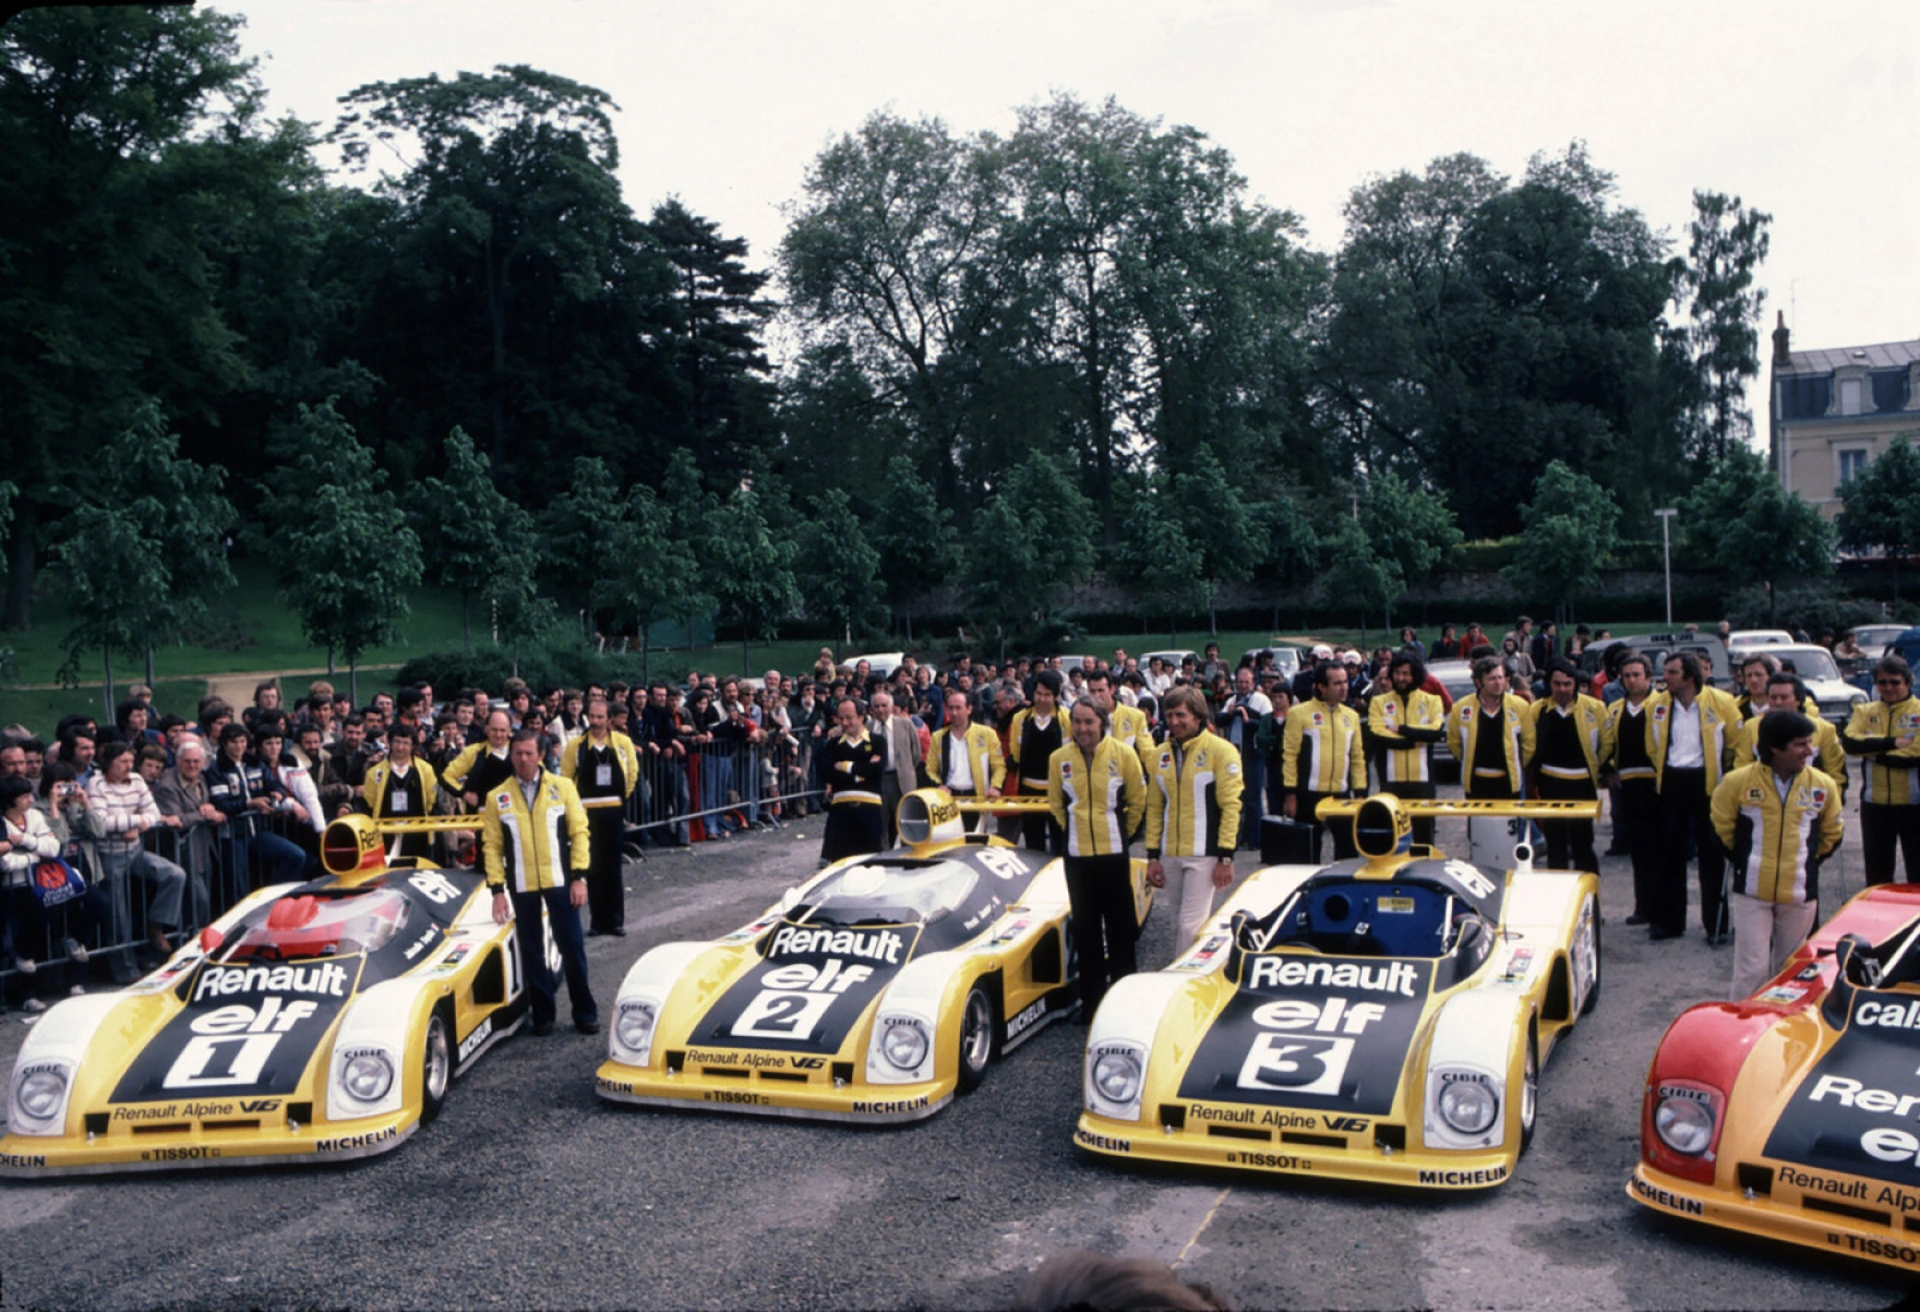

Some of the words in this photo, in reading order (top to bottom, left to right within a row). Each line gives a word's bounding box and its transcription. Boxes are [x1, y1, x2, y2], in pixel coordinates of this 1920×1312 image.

[768, 927, 903, 964] Renault
[194, 963, 348, 1002] Renault
[761, 958, 873, 993] elf
[1250, 956, 1418, 997] Renault
[190, 997, 318, 1034] elf
[751, 995, 808, 1031] 2
[1252, 997, 1386, 1034] elf
[188, 1037, 250, 1080] 1
[687, 1050, 738, 1066] Renault
[742, 1052, 785, 1069] Alpine
[790, 1055, 828, 1069] V6
[1255, 1036, 1333, 1088] 3
[113, 1103, 176, 1121] Renault
[182, 1101, 233, 1118] Alpine
[239, 1099, 283, 1113] V6
[713, 1090, 760, 1104] TISSOT
[853, 1096, 928, 1113] MICHELIN
[1190, 1103, 1255, 1124] Renault
[1261, 1109, 1316, 1129] Alpine
[1322, 1115, 1371, 1133] V6
[153, 1148, 209, 1161] TISSOT
[316, 1126, 397, 1152] MICHELIN
[1860, 1127, 1920, 1168] e
[1239, 1152, 1300, 1169] TISSOT
[1419, 1165, 1507, 1185] MICHELIN
[1778, 1166, 1868, 1201] Renault
